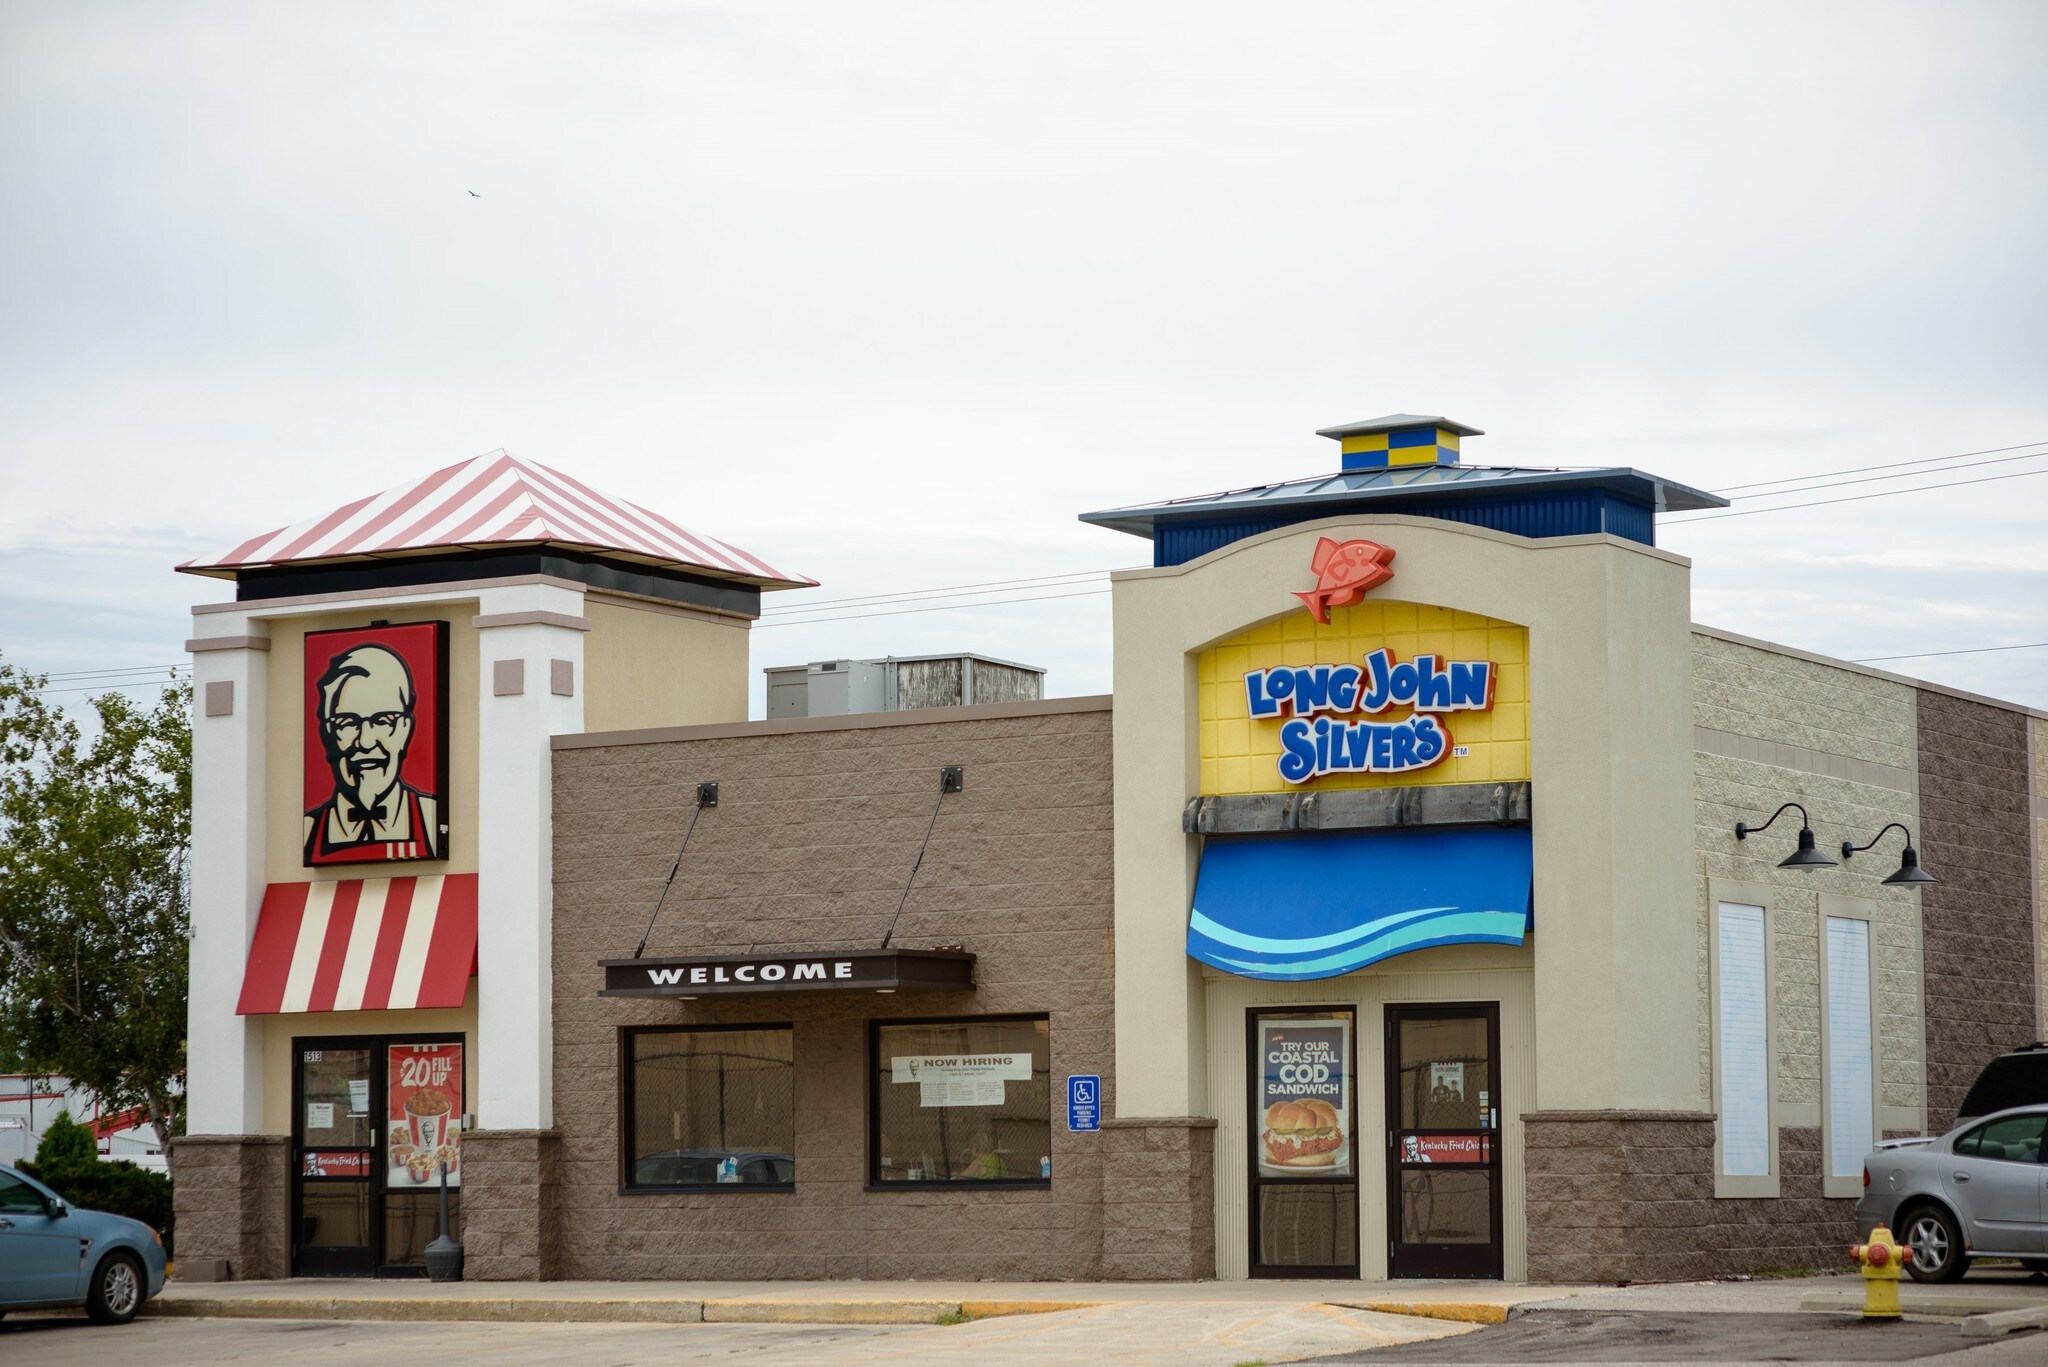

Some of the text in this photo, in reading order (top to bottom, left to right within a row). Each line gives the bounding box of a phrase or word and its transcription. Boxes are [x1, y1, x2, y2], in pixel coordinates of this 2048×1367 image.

[1454, 747, 1468, 756] TM
[647, 962, 853, 985] WELCOME
[1280, 1042, 1329, 1051] TRY OUR
[923, 1057, 1013, 1067] NOW HIRING
[1268, 1051, 1340, 1064] COASTAL
[432, 1056, 452, 1072] FILL
[432, 1071, 447, 1087] UP
[1279, 1064, 1330, 1084] COD
[1267, 1083, 1339, 1095] SANDWICH
[1420, 1140, 1490, 1152] Kentucky Fried Chicen
